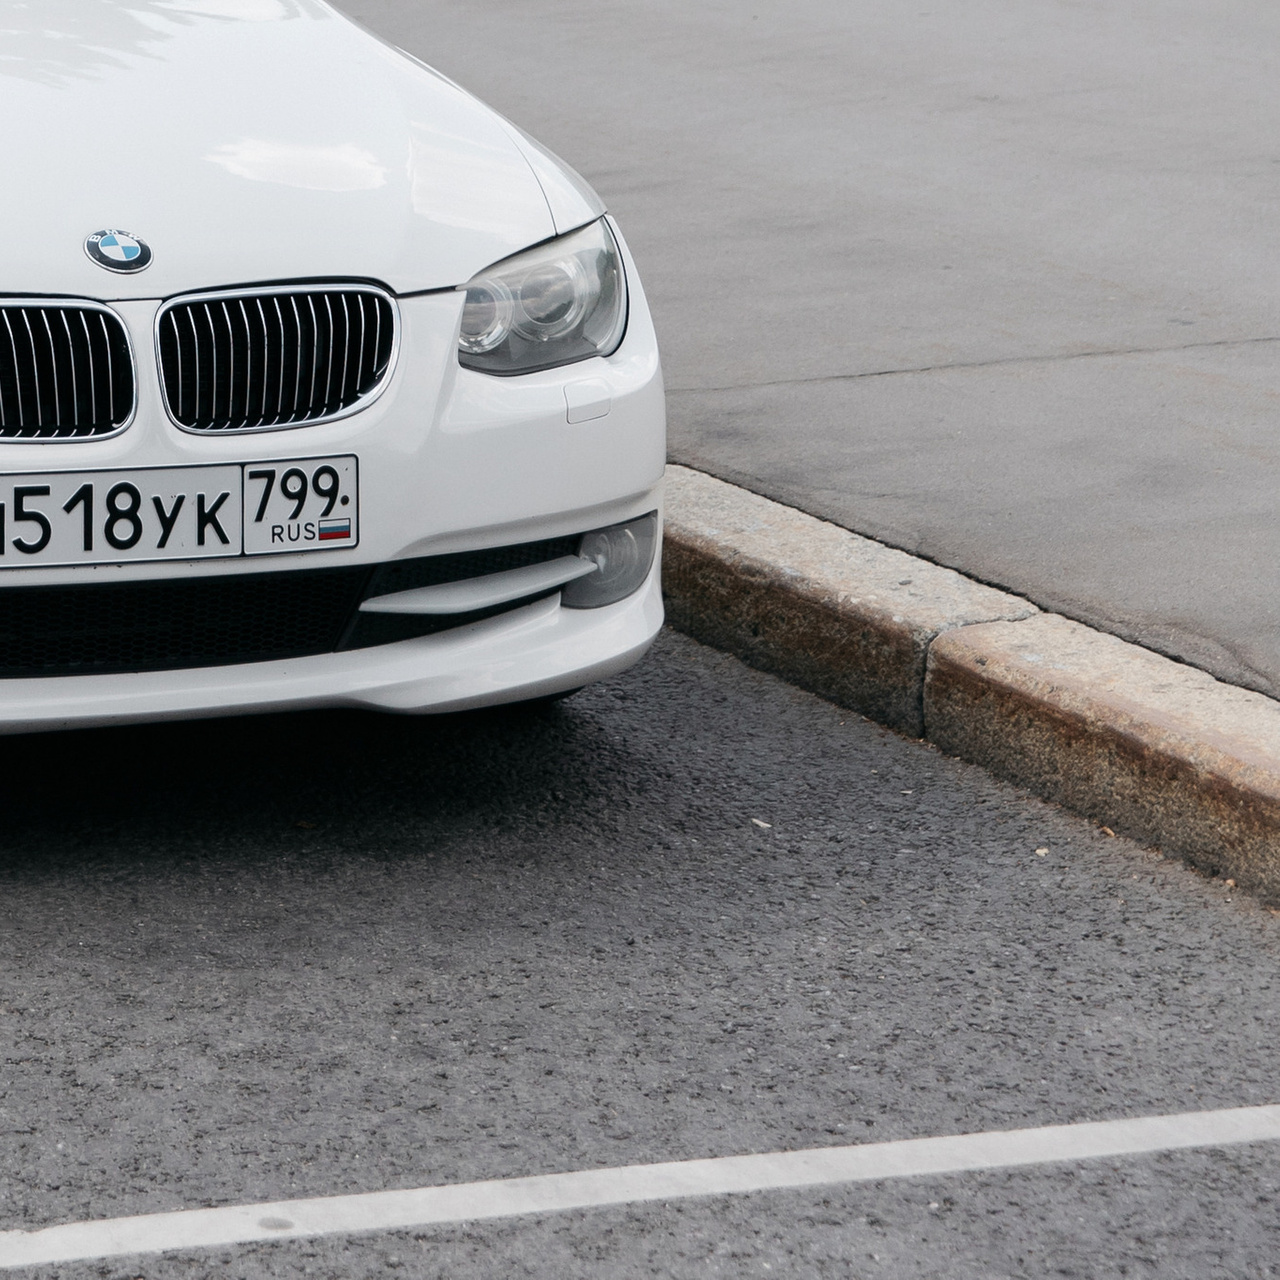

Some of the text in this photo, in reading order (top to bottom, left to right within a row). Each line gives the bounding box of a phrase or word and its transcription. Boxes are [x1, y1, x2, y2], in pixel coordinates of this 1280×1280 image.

[88, 228, 141, 243] BMW
[247, 463, 341, 523] 799
[271, 522, 317, 544] RUS
